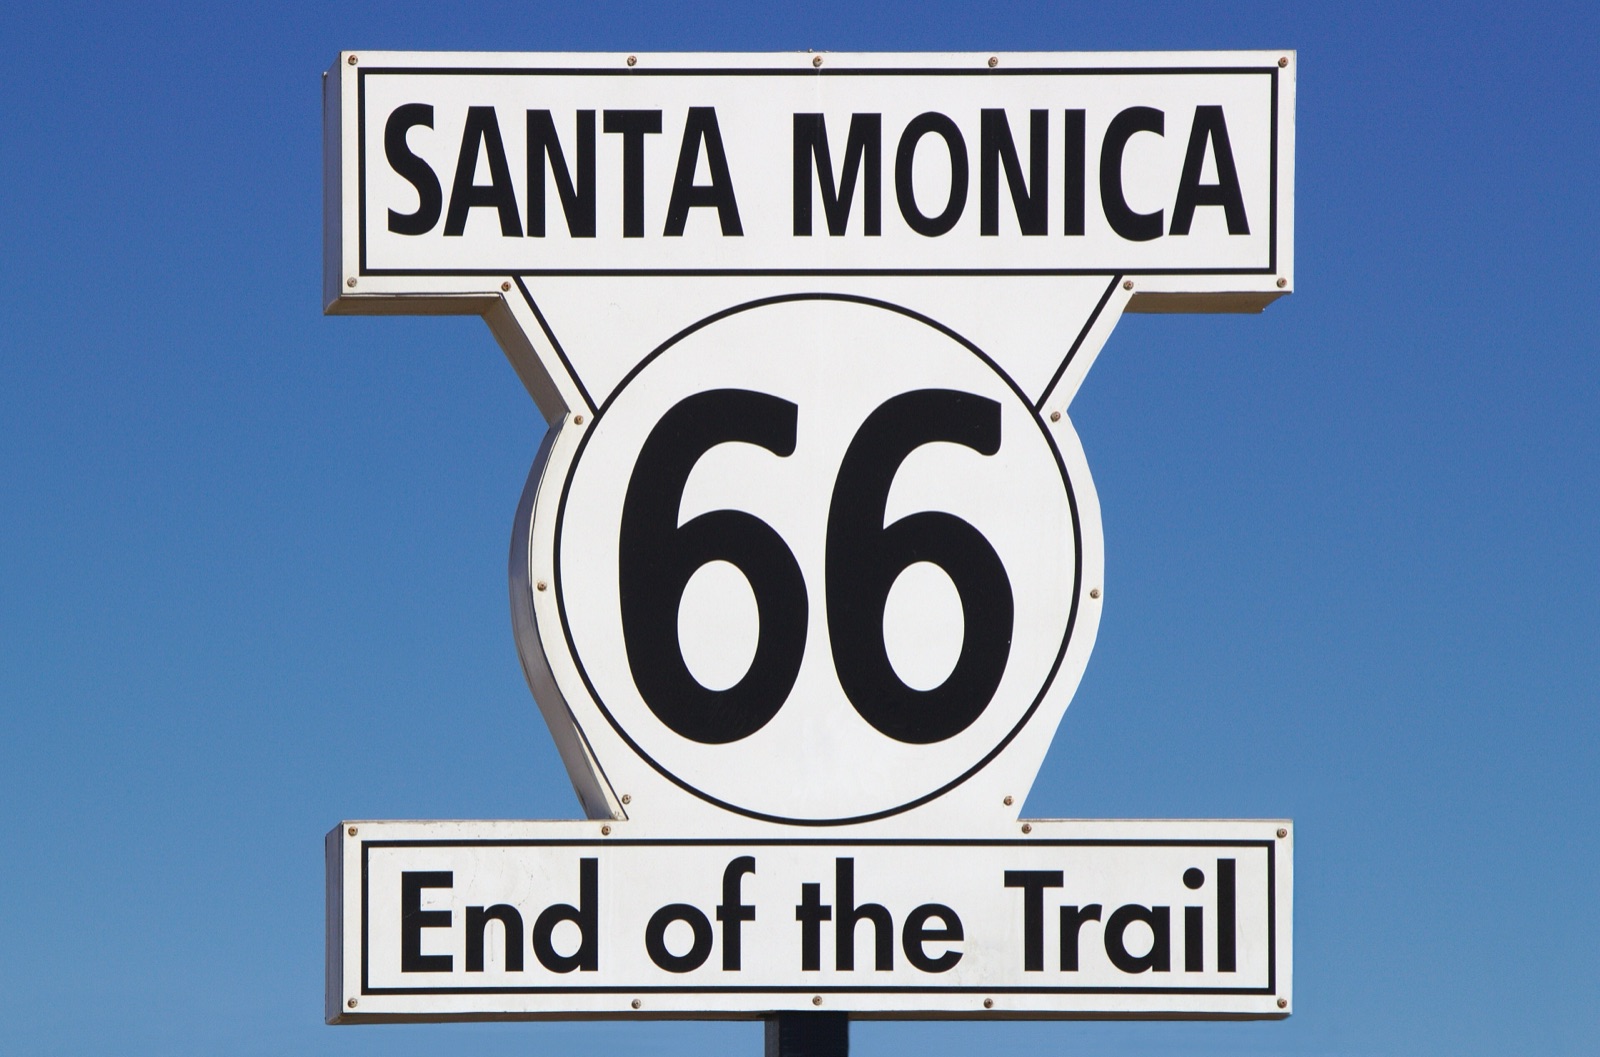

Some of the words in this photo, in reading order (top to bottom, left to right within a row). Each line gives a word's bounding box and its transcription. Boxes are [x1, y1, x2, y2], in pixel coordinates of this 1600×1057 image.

[384, 103, 744, 238] SANTA
[793, 105, 1251, 242] MONICA
[618, 388, 1015, 745] 66
[401, 857, 599, 974] End
[645, 855, 756, 974] of
[795, 857, 965, 974] the
[1003, 858, 1237, 974] Trail
